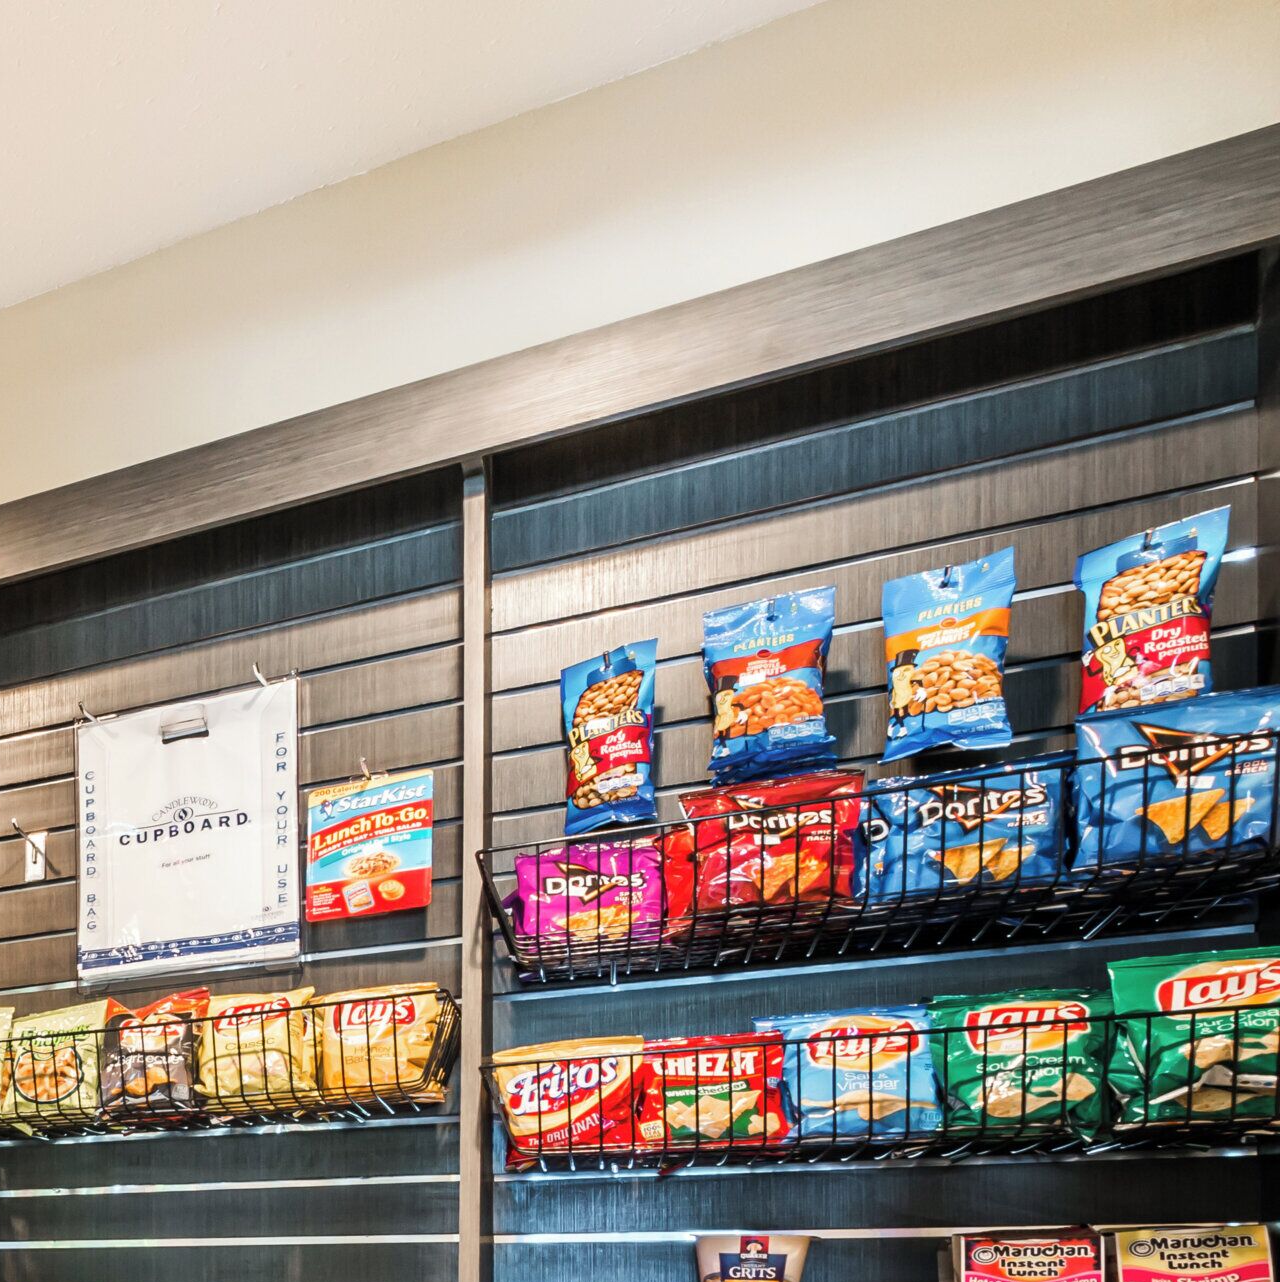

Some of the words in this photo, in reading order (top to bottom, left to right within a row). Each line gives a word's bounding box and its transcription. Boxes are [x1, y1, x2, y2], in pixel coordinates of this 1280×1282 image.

[917, 596, 983, 623] PLANTERS
[1090, 595, 1201, 643] PLANTERS
[733, 633, 795, 652] PLANTERS
[1144, 632, 1208, 653] Roasted
[1151, 626, 1181, 642] Dry
[1158, 641, 1208, 660] peanuts
[600, 741, 642, 755] Roasted
[606, 732, 625, 745] Dry
[610, 748, 643, 761] peanuts
[337, 784, 426, 813] StarKist
[921, 785, 1045, 825] Doritos
[151, 796, 218, 822] CANDLEWOOD
[119, 812, 248, 846] CUPBOARD
[728, 809, 833, 831] Doritos
[313, 818, 370, 850] Lunch
[975, 1003, 1086, 1043] Lay's
[509, 1057, 618, 1114] Fritos
[837, 1077, 900, 1093] Vinegar
[993, 1244, 1090, 1258] Maruchan
[1150, 1234, 1255, 1250] Maruchan
[1000, 1258, 1065, 1269] Instant
[1159, 1249, 1229, 1261] Instant
[1168, 1259, 1223, 1270] Lunch
[729, 1267, 776, 1279] GRITS
[1007, 1268, 1059, 1277] Lunch
